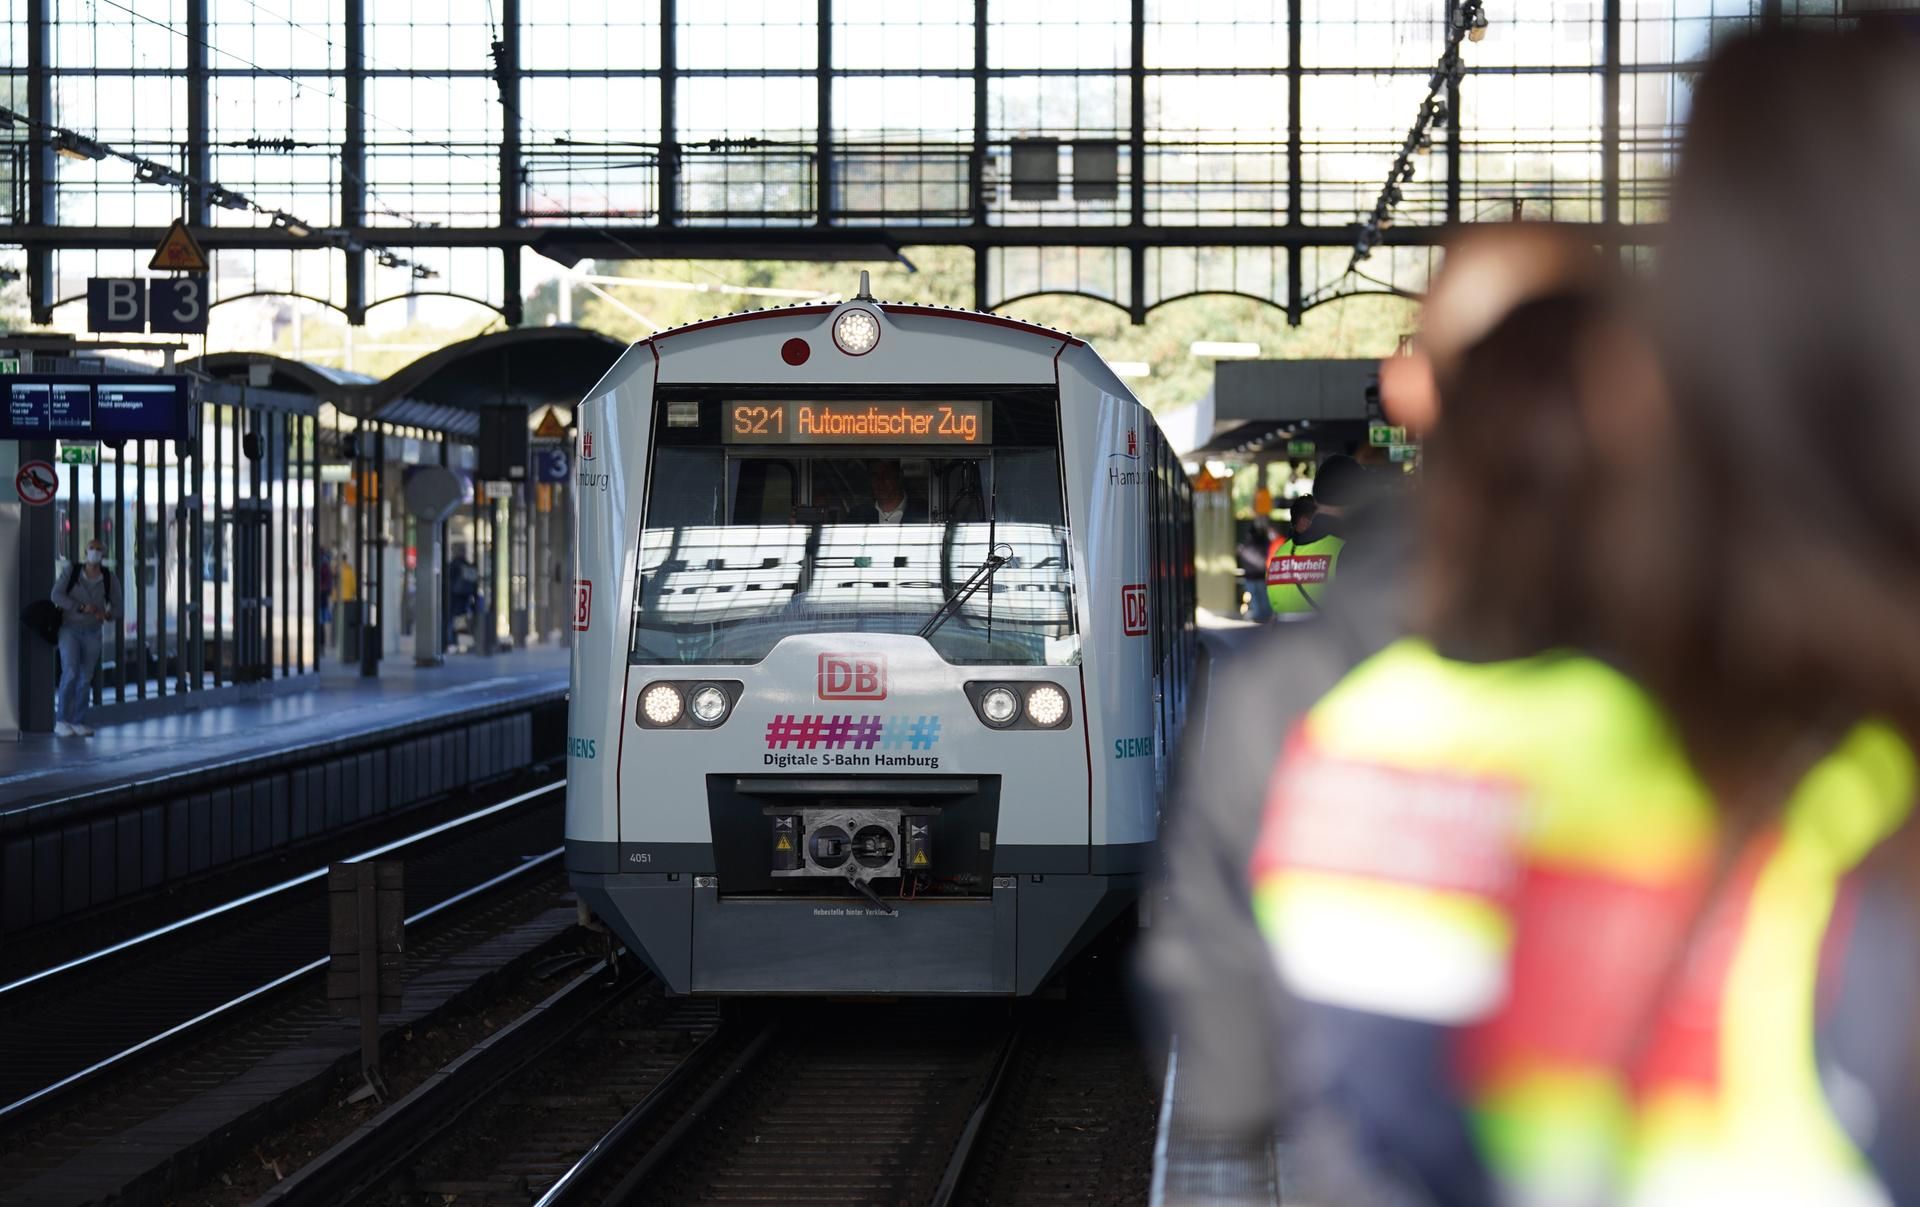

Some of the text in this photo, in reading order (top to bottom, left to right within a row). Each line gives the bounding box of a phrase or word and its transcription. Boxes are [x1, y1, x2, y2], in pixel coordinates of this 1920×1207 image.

[108, 279, 138, 321] B
[172, 279, 200, 323] 3
[734, 406, 976, 441] S21 Automatischer Zug
[549, 449, 569, 478] 3
[1281, 558, 1327, 572] Siherheit
[1126, 593, 1147, 628] DB
[827, 660, 878, 693] DB
[764, 753, 939, 768] Digitale S-Bahn Hamburg
[630, 853, 651, 863] 4051
